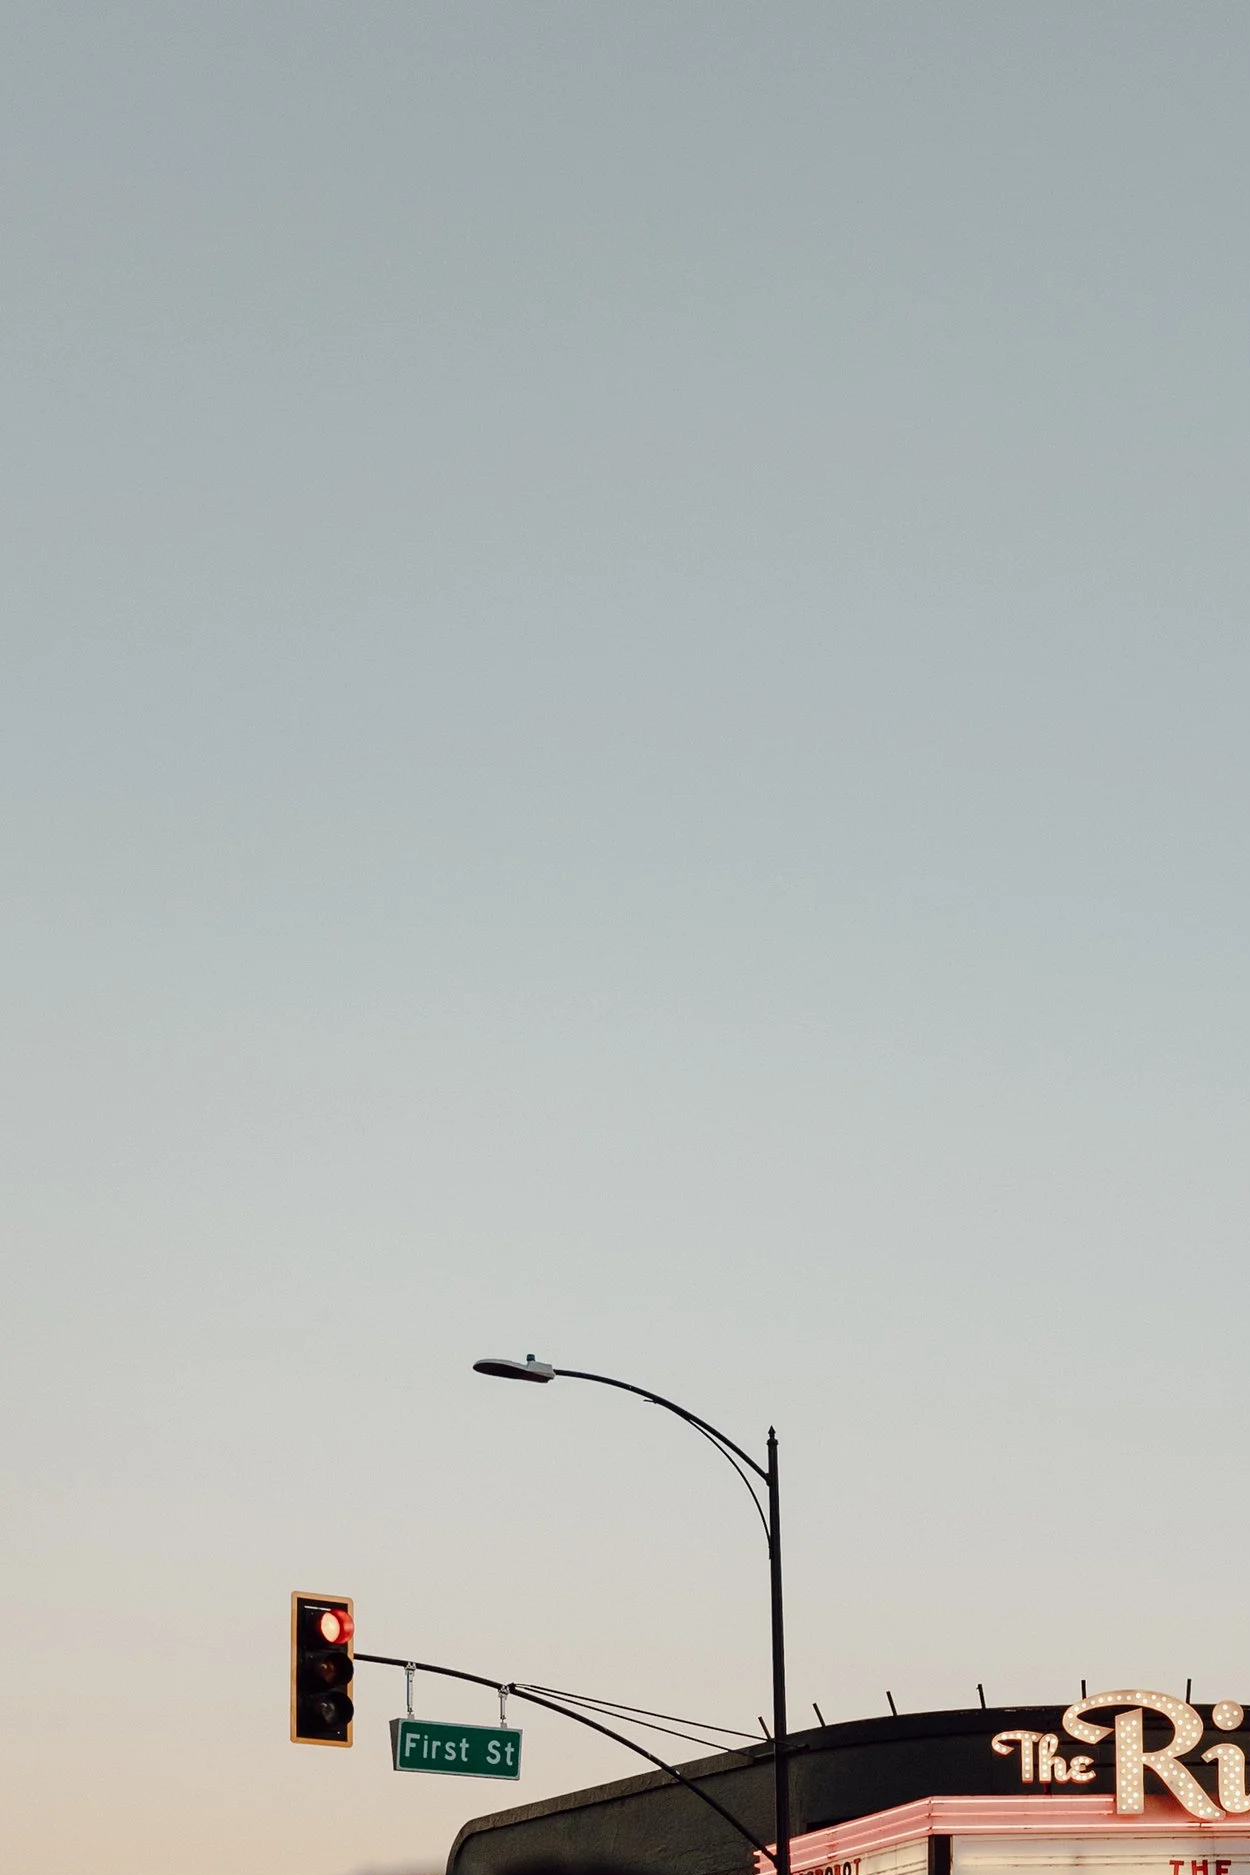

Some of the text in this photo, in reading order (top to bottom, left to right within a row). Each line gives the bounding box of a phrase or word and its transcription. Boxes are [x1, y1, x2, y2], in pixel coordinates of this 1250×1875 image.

[404, 1732, 515, 1766] First St
[991, 1730, 1098, 1785] The
